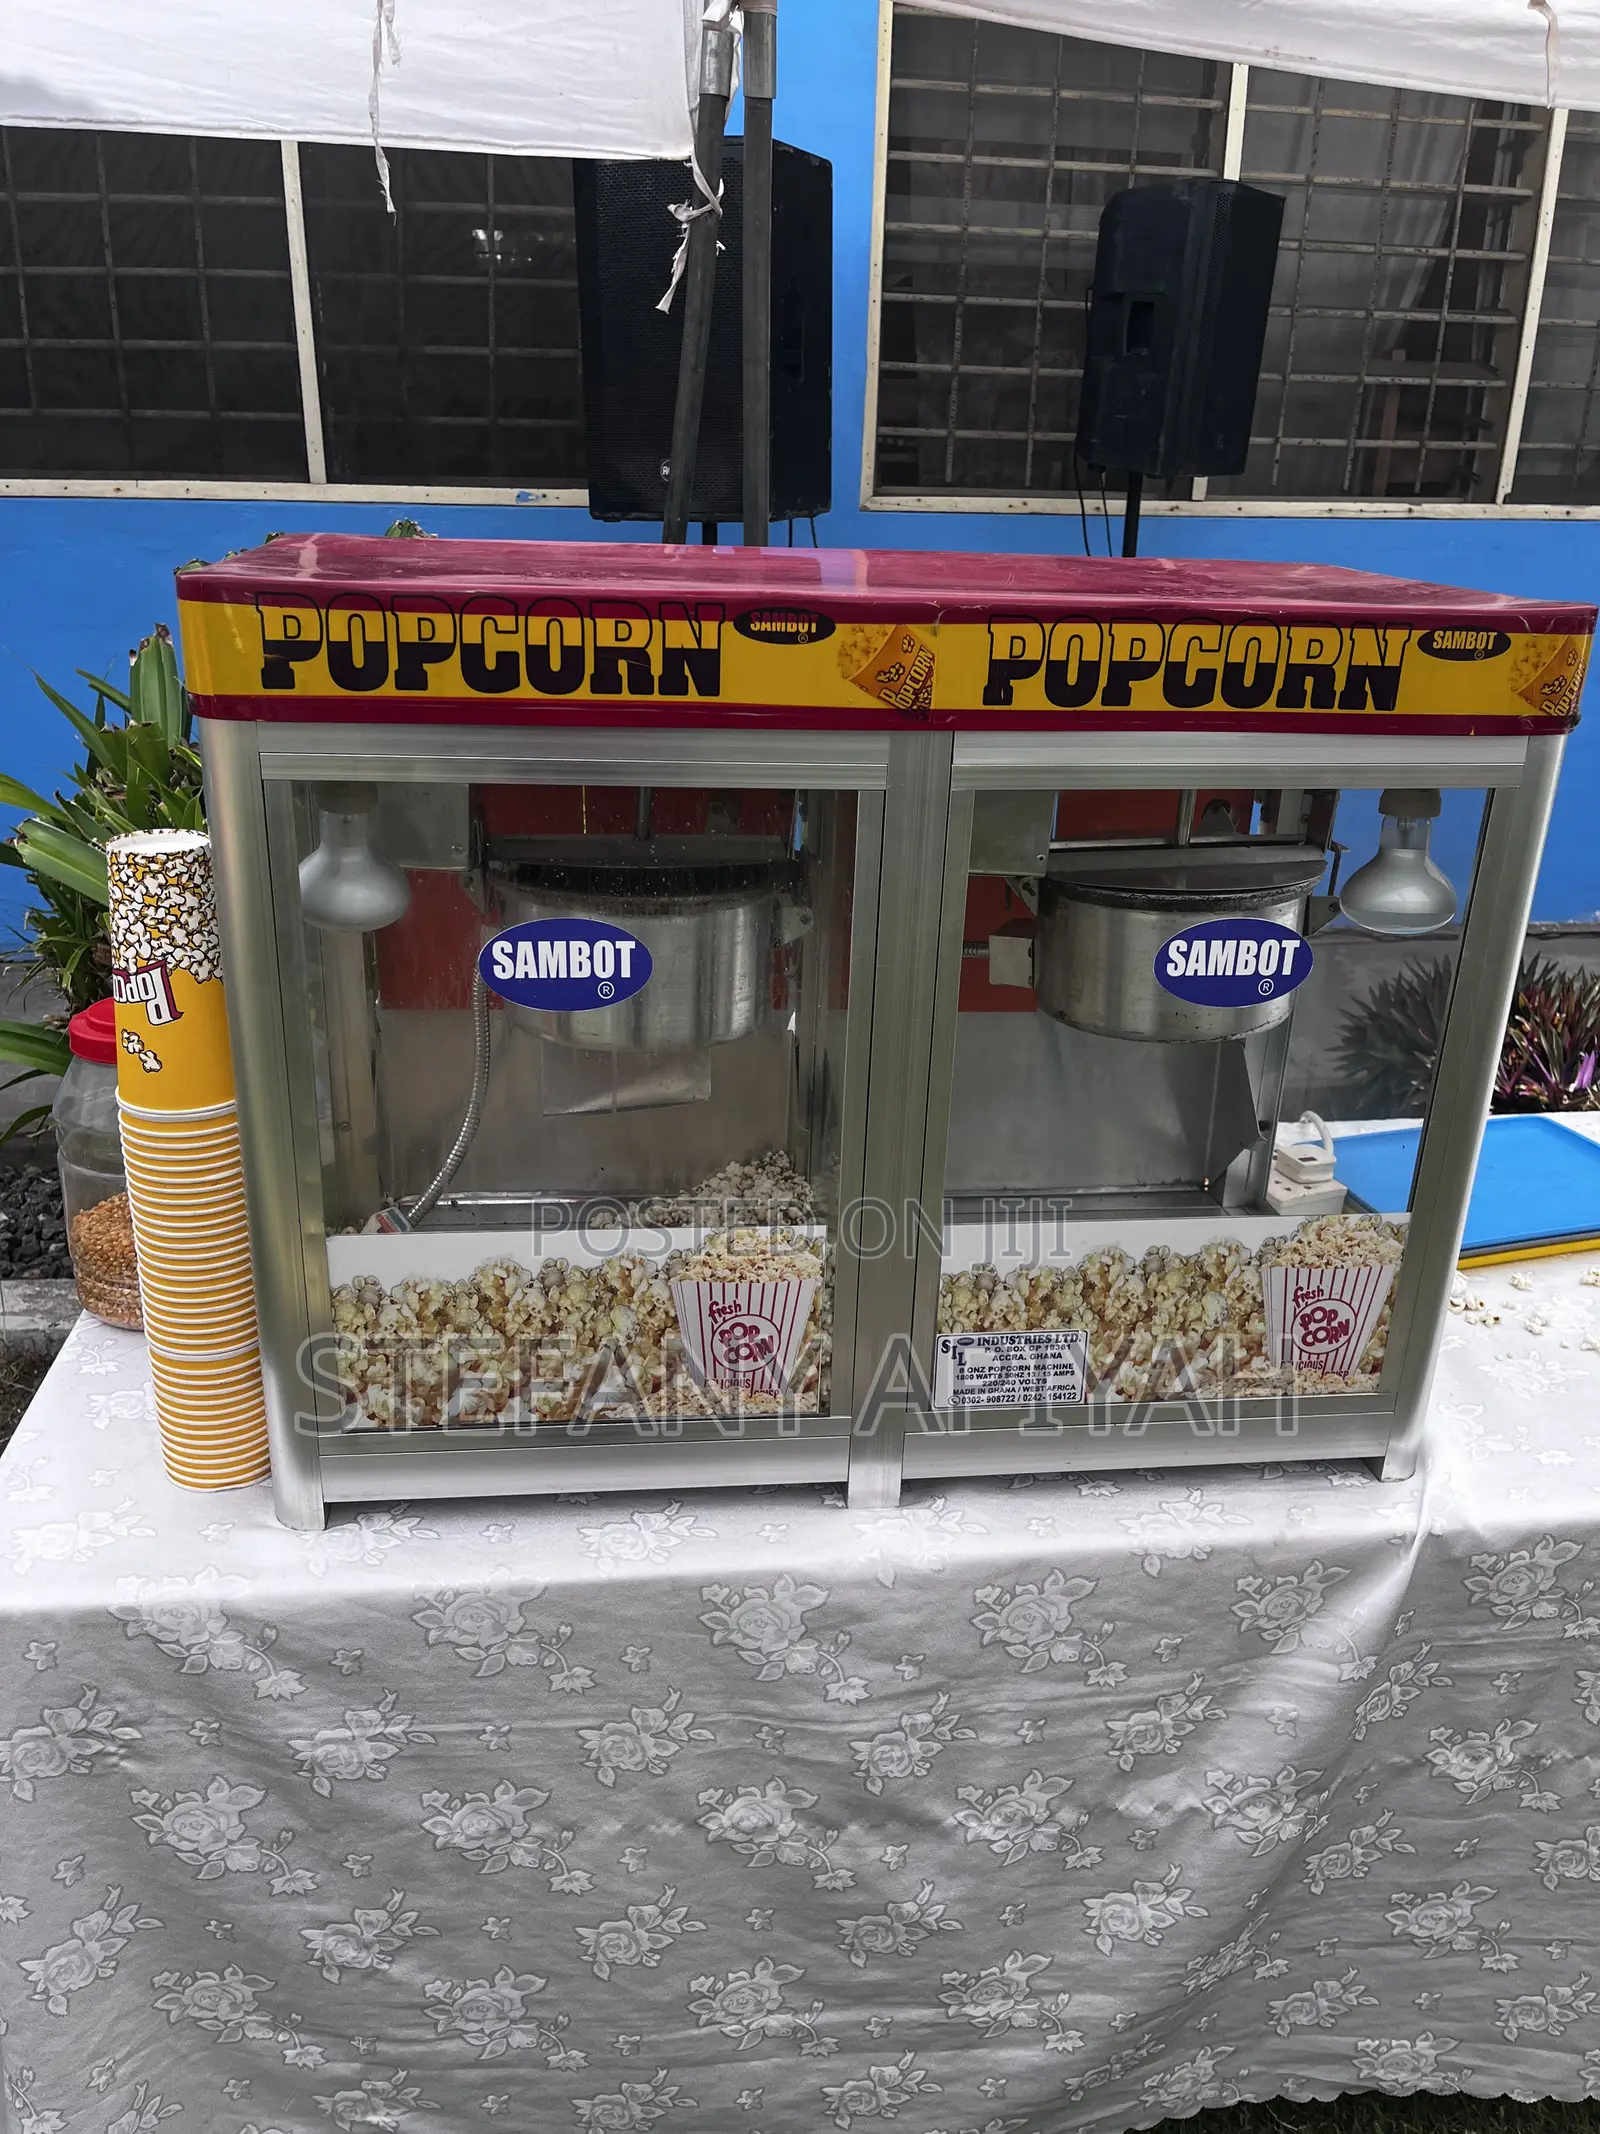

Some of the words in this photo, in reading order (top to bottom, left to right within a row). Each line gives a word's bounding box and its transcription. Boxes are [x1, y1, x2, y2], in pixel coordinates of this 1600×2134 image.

[750, 611, 817, 633] SAMBOT
[255, 592, 726, 697] POPCORN
[1432, 630, 1498, 650] SAMBOT
[982, 614, 1412, 711] POPCORN
[492, 940, 636, 980] SAMBOT
[1166, 939, 1301, 977] SAMBOT
[1293, 1285, 1324, 1309] fresh
[708, 1299, 742, 1325] fresh
[1299, 1306, 1339, 1331] POP
[718, 1321, 761, 1347] POP
[977, 1334, 1052, 1347] INDUSTRIES
[1055, 1333, 1081, 1344] LTD.
[1301, 1318, 1351, 1347] CORN
[723, 1335, 775, 1365] CORN
[1030, 1352, 1062, 1360] GHANA
[967, 1366, 986, 1374] ONZ
[988, 1364, 1031, 1373] POPCORN
[1034, 1363, 1074, 1371] MACHINE
[1053, 1369, 1075, 1377] AMPS
[982, 1379, 1016, 1387] 220/240
